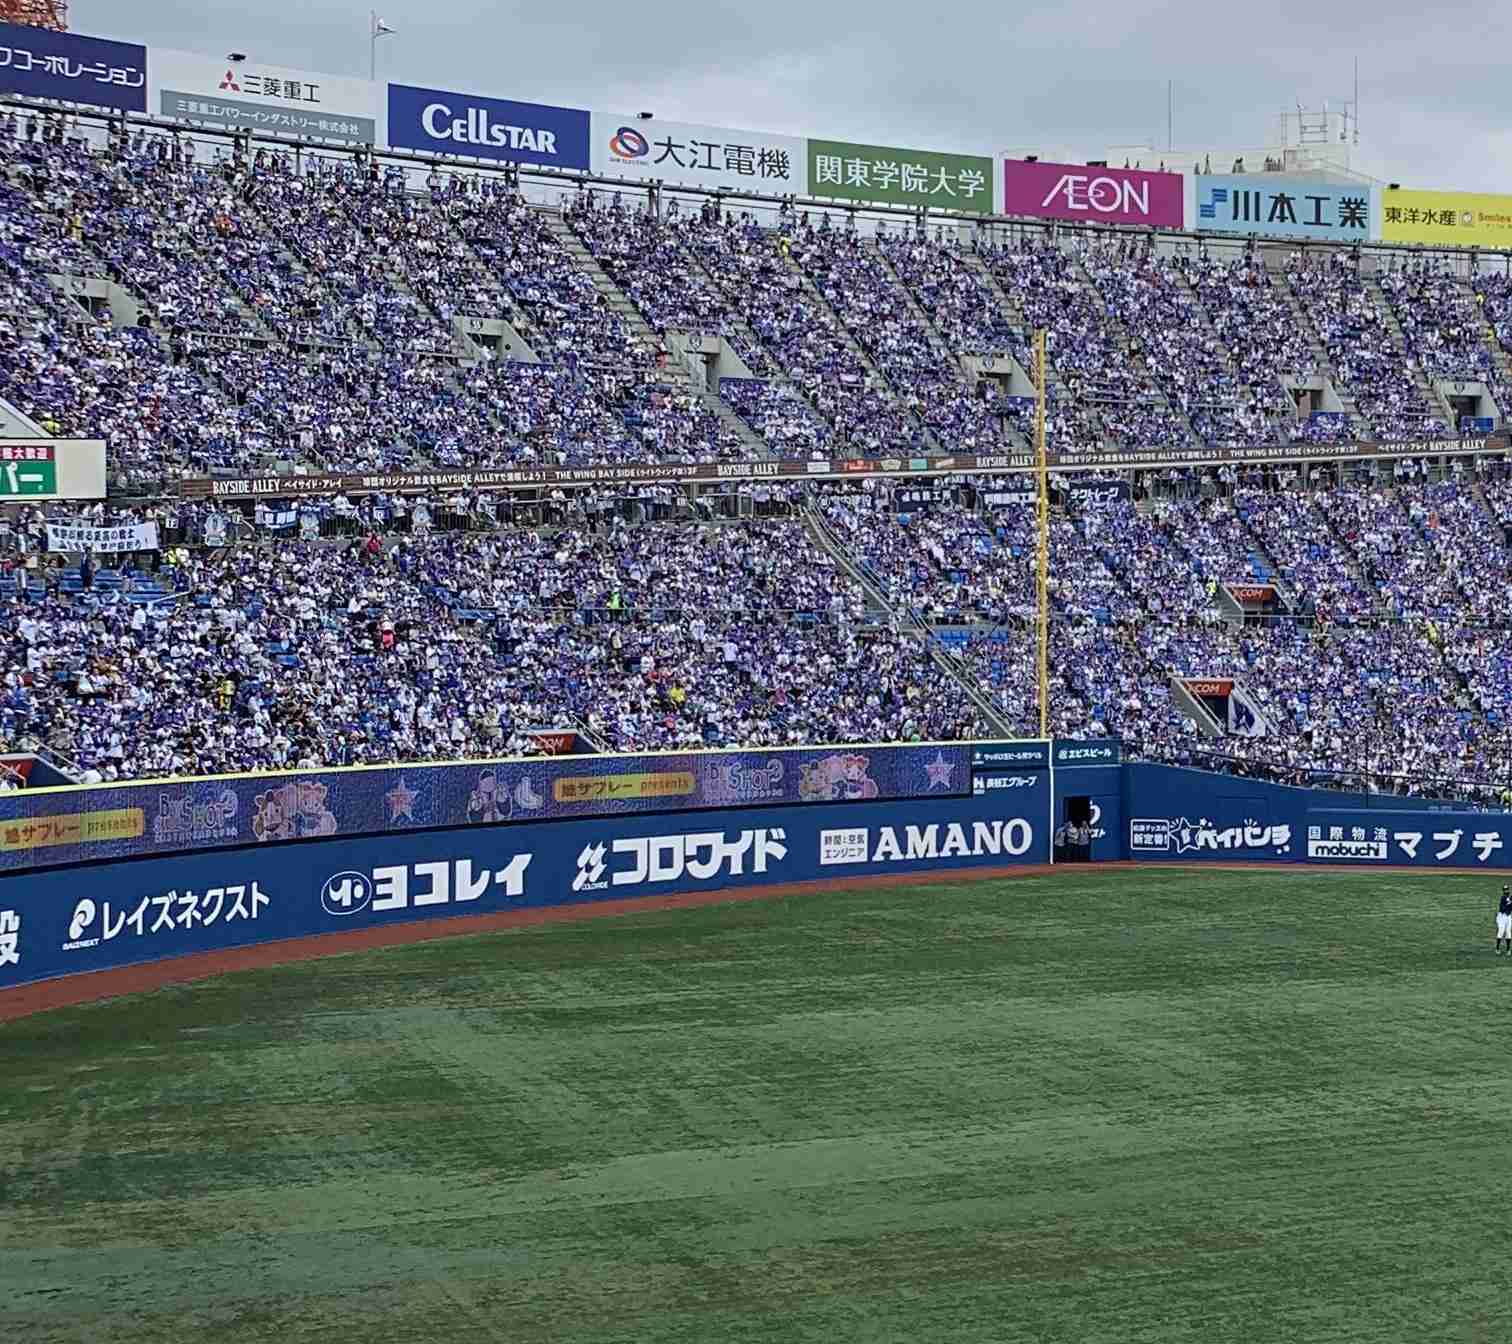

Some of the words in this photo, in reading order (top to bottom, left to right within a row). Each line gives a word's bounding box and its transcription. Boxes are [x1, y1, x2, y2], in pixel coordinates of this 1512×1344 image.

[243, 73, 321, 102] 三菱重工
[653, 135, 791, 181] 大江電機
[815, 154, 986, 199] 関東学院大学
[1231, 190, 1369, 230] 川本工業
[1384, 207, 1457, 225] 東洋水産
[213, 480, 250, 495] BAYSIDE
[252, 479, 281, 493] ALLEY
[824, 847, 865, 859] エンジニア
[871, 817, 1033, 861] AMANO
[1308, 826, 1388, 840] 国際物流
[1394, 829, 1503, 861] マブチ
[611, 826, 789, 886] コロワイド
[371, 853, 534, 911] ヨコレイ
[102, 881, 270, 941] レイズネクスト
